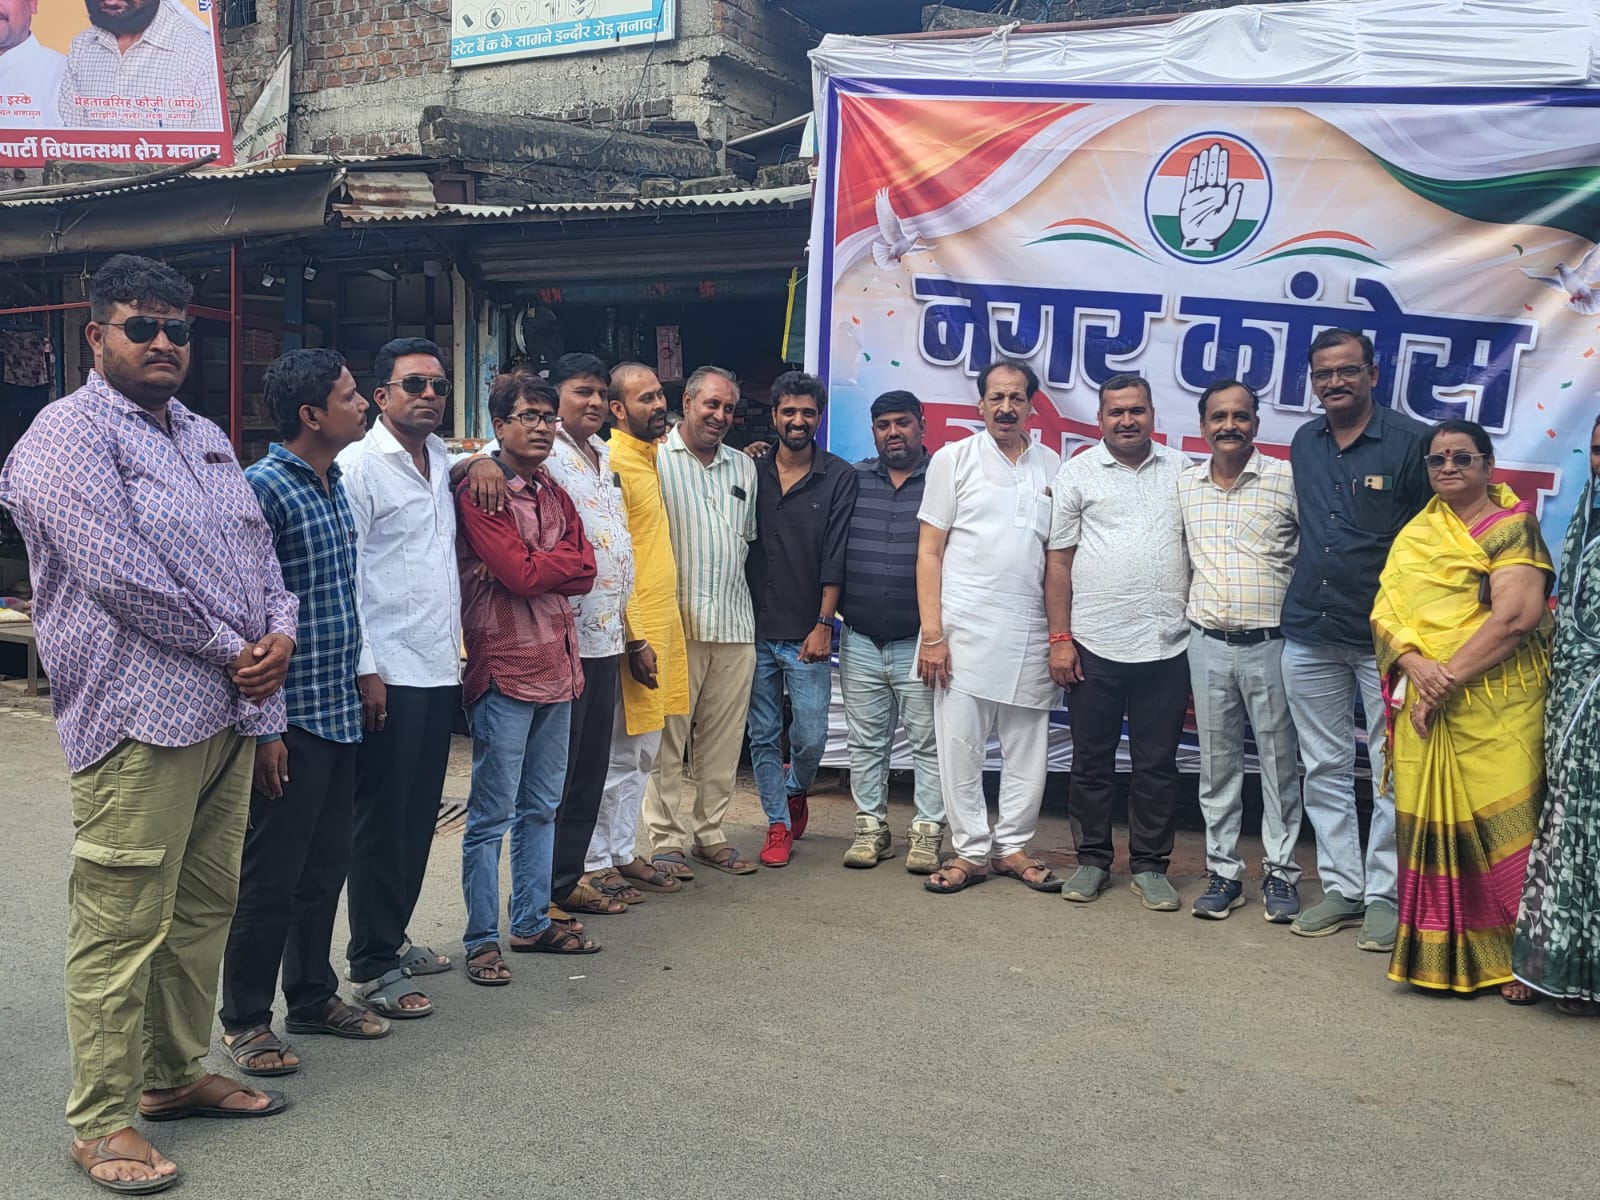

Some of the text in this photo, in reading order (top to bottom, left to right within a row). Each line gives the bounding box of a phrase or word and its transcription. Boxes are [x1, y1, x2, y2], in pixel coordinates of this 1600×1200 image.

[452, 40, 474, 56] स्टेट
[476, 36, 498, 52] बैंक
[500, 33, 513, 48] के
[515, 28, 552, 47] सामने
[555, 23, 590, 43] इन्दौर
[592, 18, 614, 39] रोड़
[0, 137, 38, 158] पार्टी
[41, 137, 130, 159] विधानसभा
[135, 138, 162, 161] क्षेत्र
[913, 275, 1166, 389] नगर
